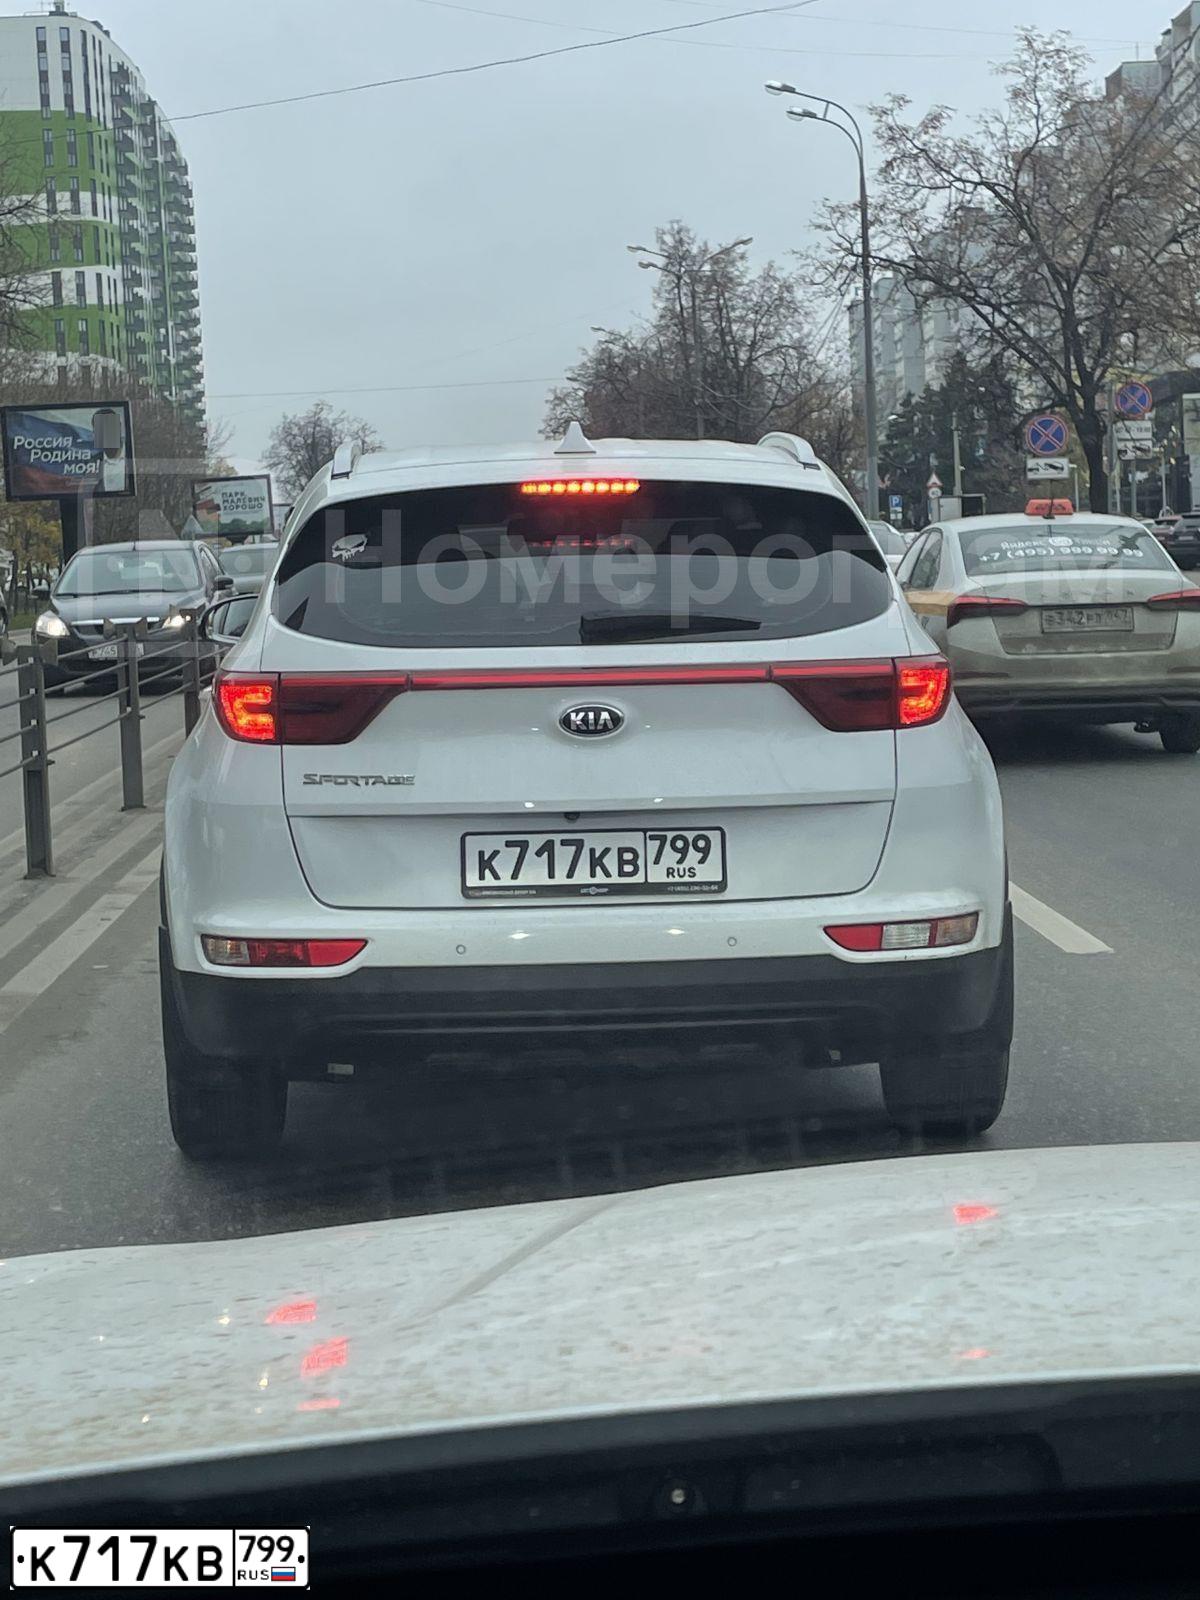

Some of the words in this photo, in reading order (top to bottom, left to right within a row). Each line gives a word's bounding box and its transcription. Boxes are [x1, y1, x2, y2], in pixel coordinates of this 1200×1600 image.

[13, 435, 73, 449] Россия
[30, 448, 91, 463] Родина
[63, 459, 100, 474] моя!
[223, 502, 264, 511] ХОРОШО
[570, 711, 614, 731] KIA
[302, 773, 416, 787] SPORTAGE
[478, 838, 640, 881] К717КВ
[648, 833, 712, 865] 799
[666, 867, 697, 879] RUS
